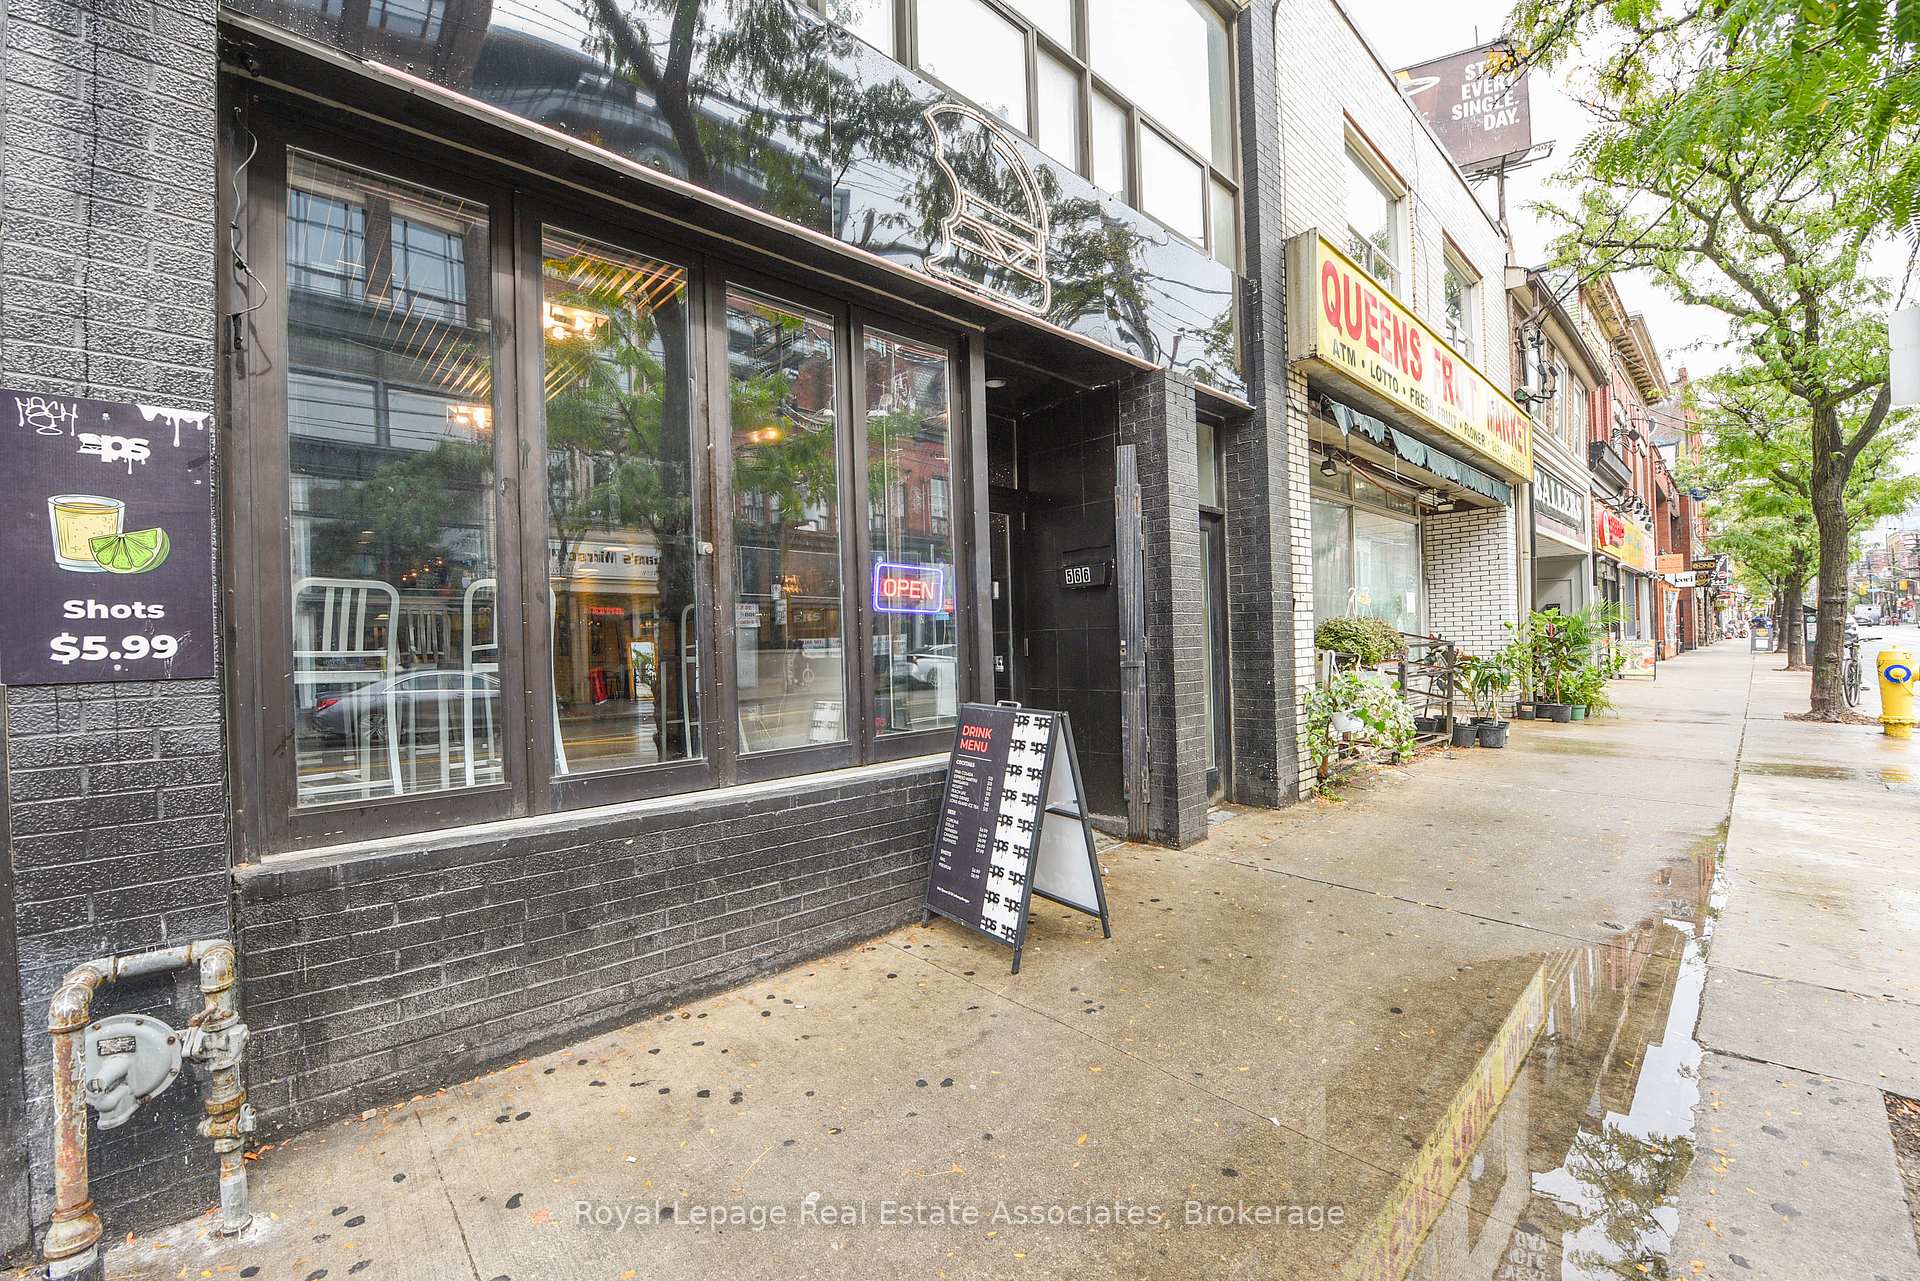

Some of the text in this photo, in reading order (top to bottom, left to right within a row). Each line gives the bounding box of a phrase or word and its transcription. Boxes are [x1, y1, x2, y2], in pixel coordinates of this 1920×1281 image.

[1483, 107, 1520, 131] DAY.
[1321, 259, 1423, 382] QUEENS
[1332, 338, 1356, 368] ATM
[1370, 360, 1398, 394] LOTTO
[1065, 568, 1091, 585] 566
[883, 578, 935, 600] OPEN
[63, 600, 166, 619] Shots
[50, 633, 179, 665] $5.99
[962, 725, 992, 740] DRINK
[960, 738, 988, 753] MENU
